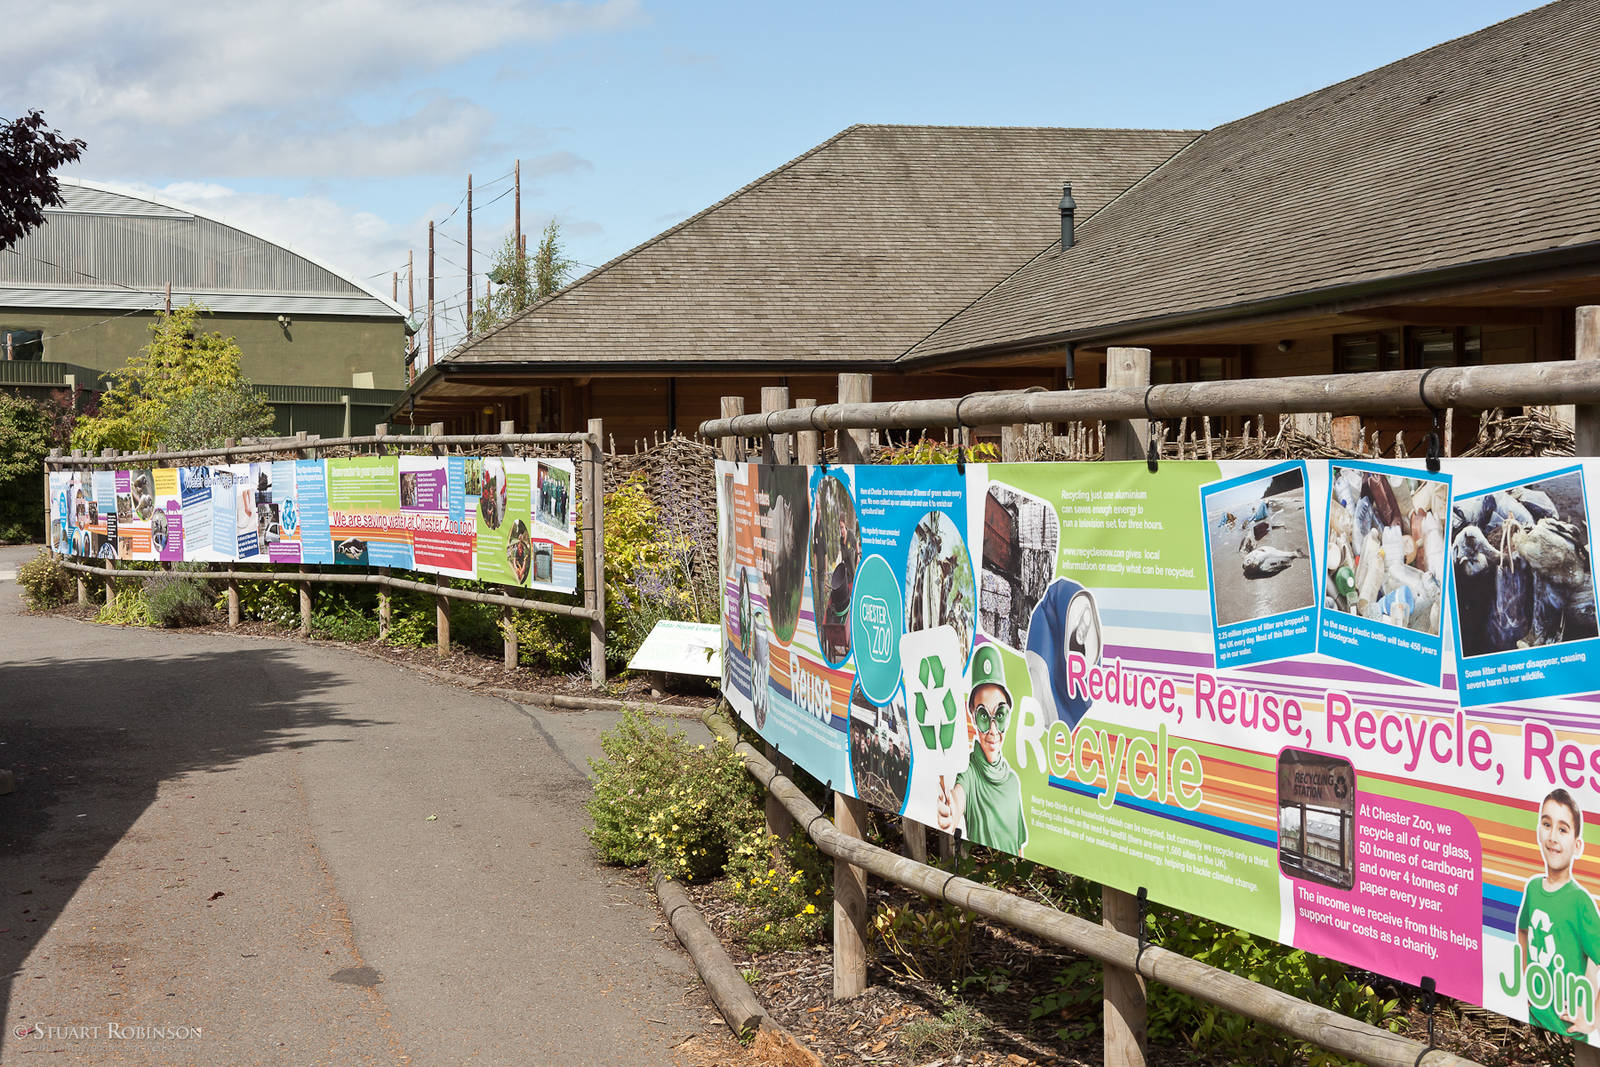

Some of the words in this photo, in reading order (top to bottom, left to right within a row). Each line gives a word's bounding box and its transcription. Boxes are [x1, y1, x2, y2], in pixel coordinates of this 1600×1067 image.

[1062, 490, 1089, 500] Recycling
[1091, 491, 1102, 501] just
[1115, 491, 1146, 499] aluminium
[1093, 505, 1112, 516] enough
[1114, 506, 1136, 516] energy
[1138, 505, 1143, 514] to
[333, 512, 346, 527] We
[348, 514, 362, 528] are
[364, 513, 388, 531] saving
[389, 516, 406, 529] water
[408, 516, 415, 530] at
[416, 514, 442, 532] Chester
[444, 516, 458, 533] Zoo
[460, 519, 476, 536] too!
[1079, 519, 1104, 528] television
[1105, 520, 1117, 528] set
[1118, 519, 1127, 528] for
[1128, 520, 1142, 529] three
[1144, 520, 1164, 530] hours.
[1062, 561, 1097, 570] information
[1108, 562, 1124, 575] exactly
[1126, 564, 1141, 573] what
[1143, 566, 1154, 574] can
[1156, 565, 1164, 575] be
[1145, 550, 1160, 559] local
[863, 603, 886, 624] CHESTER
[1218, 632, 1227, 640] 2.25
[1243, 627, 1257, 636] pieces
[1263, 622, 1274, 630] litter
[1284, 616, 1303, 626] dropped
[872, 626, 890, 656] ZOO
[1234, 639, 1245, 647] every
[1246, 637, 1254, 645] day.
[1256, 634, 1267, 642] Most
[1283, 629, 1294, 637] litter
[1329, 631, 1359, 646] biodegrade.
[1330, 621, 1338, 629] the
[1353, 627, 1370, 638] plastic
[1371, 631, 1386, 642] bottle
[1388, 636, 1396, 645] will
[1398, 638, 1409, 648] take
[1410, 642, 1420, 651] 450
[1421, 646, 1437, 655] years
[1465, 670, 1481, 678] Some
[1482, 667, 1496, 675] litter
[1498, 664, 1507, 673] will
[1508, 662, 1524, 671] never
[1526, 657, 1559, 669] disappear,
[1561, 652, 1585, 663] causing
[1467, 681, 1485, 690] severe
[1487, 678, 1502, 687] harm
[1503, 676, 1509, 684] to
[1510, 675, 1520, 683] our
[1521, 670, 1545, 681] wildlife.
[790, 652, 832, 724] Reuse
[1068, 654, 1183, 724] Reduce,
[1196, 673, 1312, 747] Reuse,
[1327, 693, 1504, 785] Recycle,
[1016, 696, 1203, 810] Recycle
[1294, 785, 1322, 799] STATION
[1295, 772, 1333, 786] RECYCLING
[1360, 804, 1370, 818] At
[1372, 807, 1410, 826] Chester
[1413, 815, 1434, 834] Zoo,
[1437, 823, 1451, 835] we
[1166, 832, 1176, 840] but
[1177, 836, 1202, 851] currently
[1204, 844, 1211, 852] we
[1213, 845, 1233, 858] recycle
[1235, 852, 1248, 864] only
[1254, 855, 1270, 867] third.
[1360, 825, 1394, 841] recycle
[1396, 832, 1407, 845] all
[1410, 835, 1420, 848] of
[1423, 841, 1440, 852] our
[1443, 843, 1472, 863] glass,
[1164, 856, 1185, 872] helping
[1187, 863, 1192, 872] to
[1193, 864, 1211, 878] tackle
[1212, 872, 1233, 885] climate
[1235, 878, 1258, 892] change.
[1360, 841, 1371, 855] 50
[1373, 844, 1406, 863] tonnes
[1409, 854, 1418, 866] of
[1422, 859, 1474, 880] cardboard
[1360, 862, 1377, 876] and
[1380, 867, 1401, 880] over
[1403, 871, 1409, 883] 4
[1412, 873, 1445, 893] tonnes
[1448, 884, 1458, 896] of
[1360, 881, 1388, 896] paper
[1390, 889, 1417, 907] every
[1419, 896, 1443, 912] year.
[1298, 887, 1314, 902] The
[1317, 892, 1350, 912] income
[1352, 905, 1365, 916] we
[1368, 909, 1402, 928] receive
[1405, 918, 1428, 935] from
[1430, 925, 1448, 941] this
[1450, 930, 1478, 950] helps
[1300, 906, 1333, 926] support
[1335, 918, 1350, 931] our
[1352, 922, 1378, 940] costs
[1380, 932, 1392, 943] as
[1394, 935, 1400, 946] a
[1402, 937, 1438, 960] charity.
[1499, 944, 1592, 1023] Join
